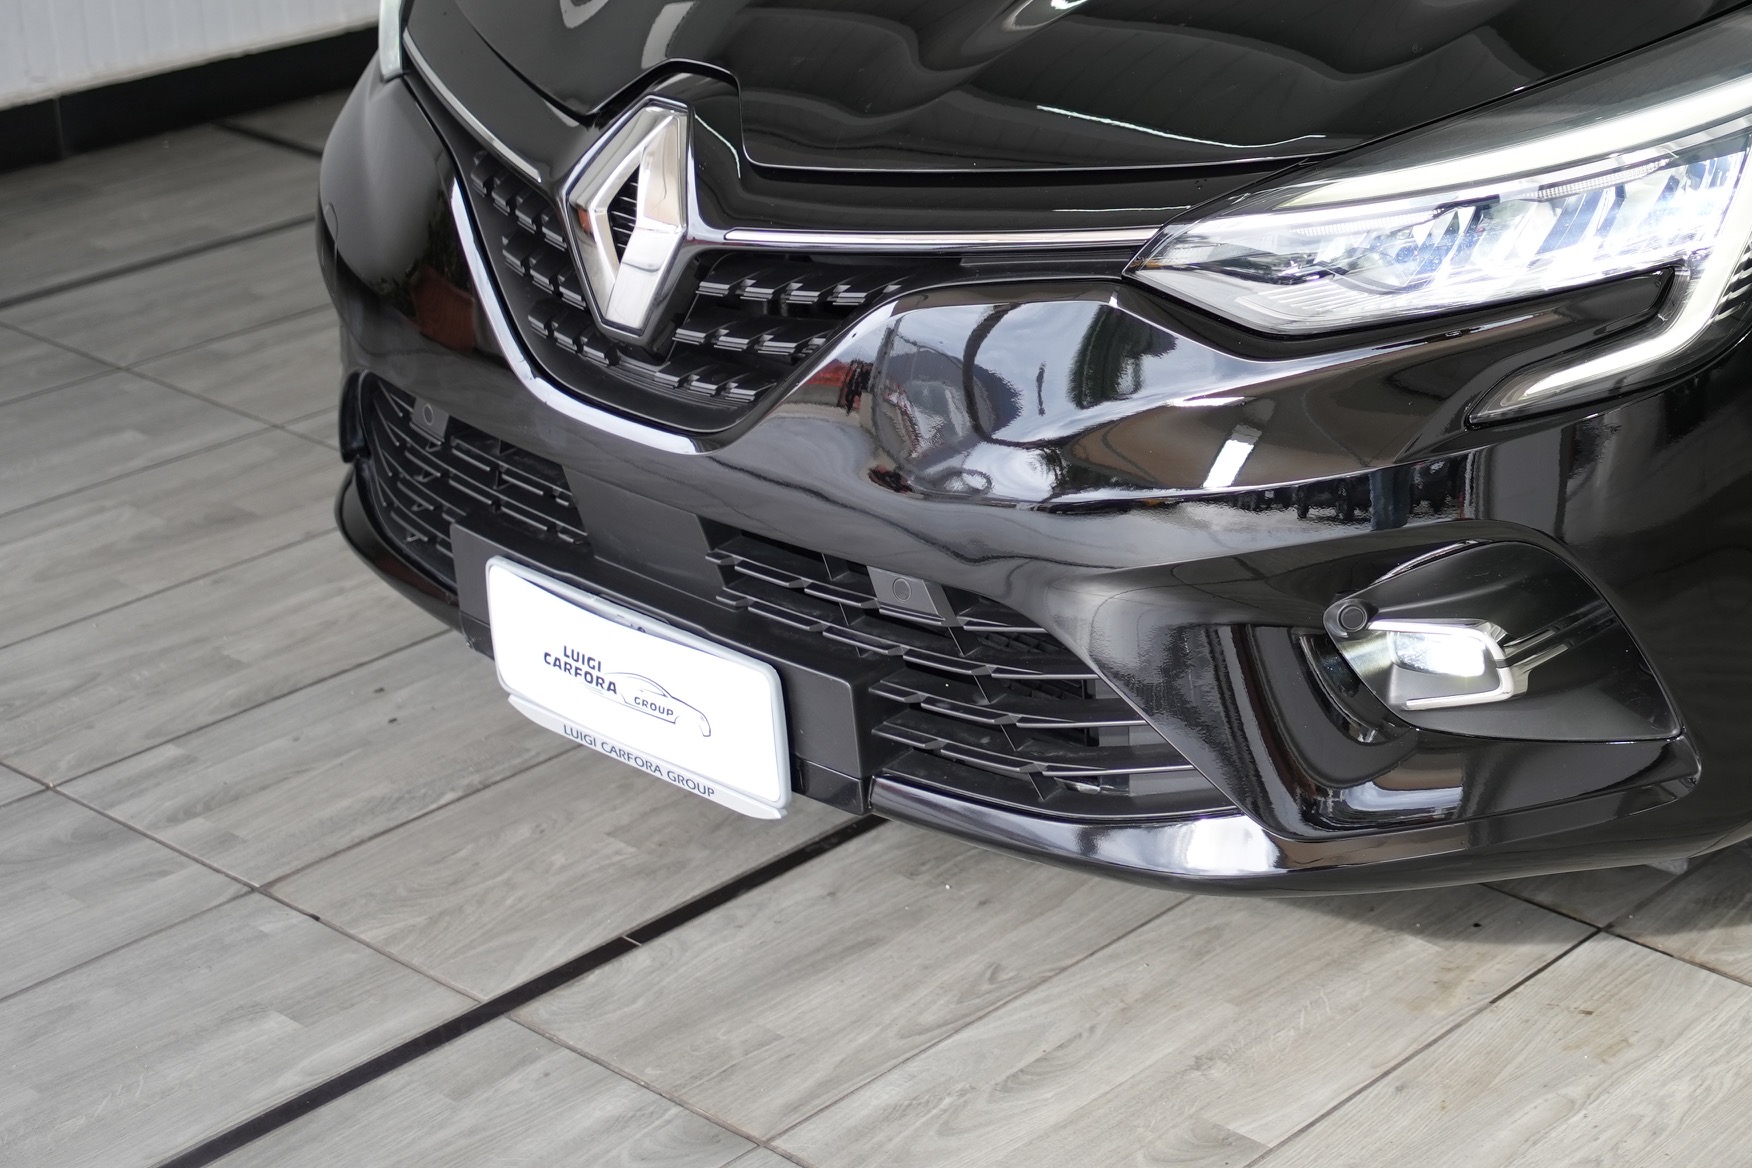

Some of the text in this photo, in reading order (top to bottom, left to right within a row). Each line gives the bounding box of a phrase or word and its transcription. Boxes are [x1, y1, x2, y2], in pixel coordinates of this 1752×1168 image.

[544, 652, 617, 694] CARFORA
[563, 645, 601, 672] LUIGI
[634, 696, 674, 716] GROUP
[563, 724, 715, 797] LUIGI CARFORA GROUP
